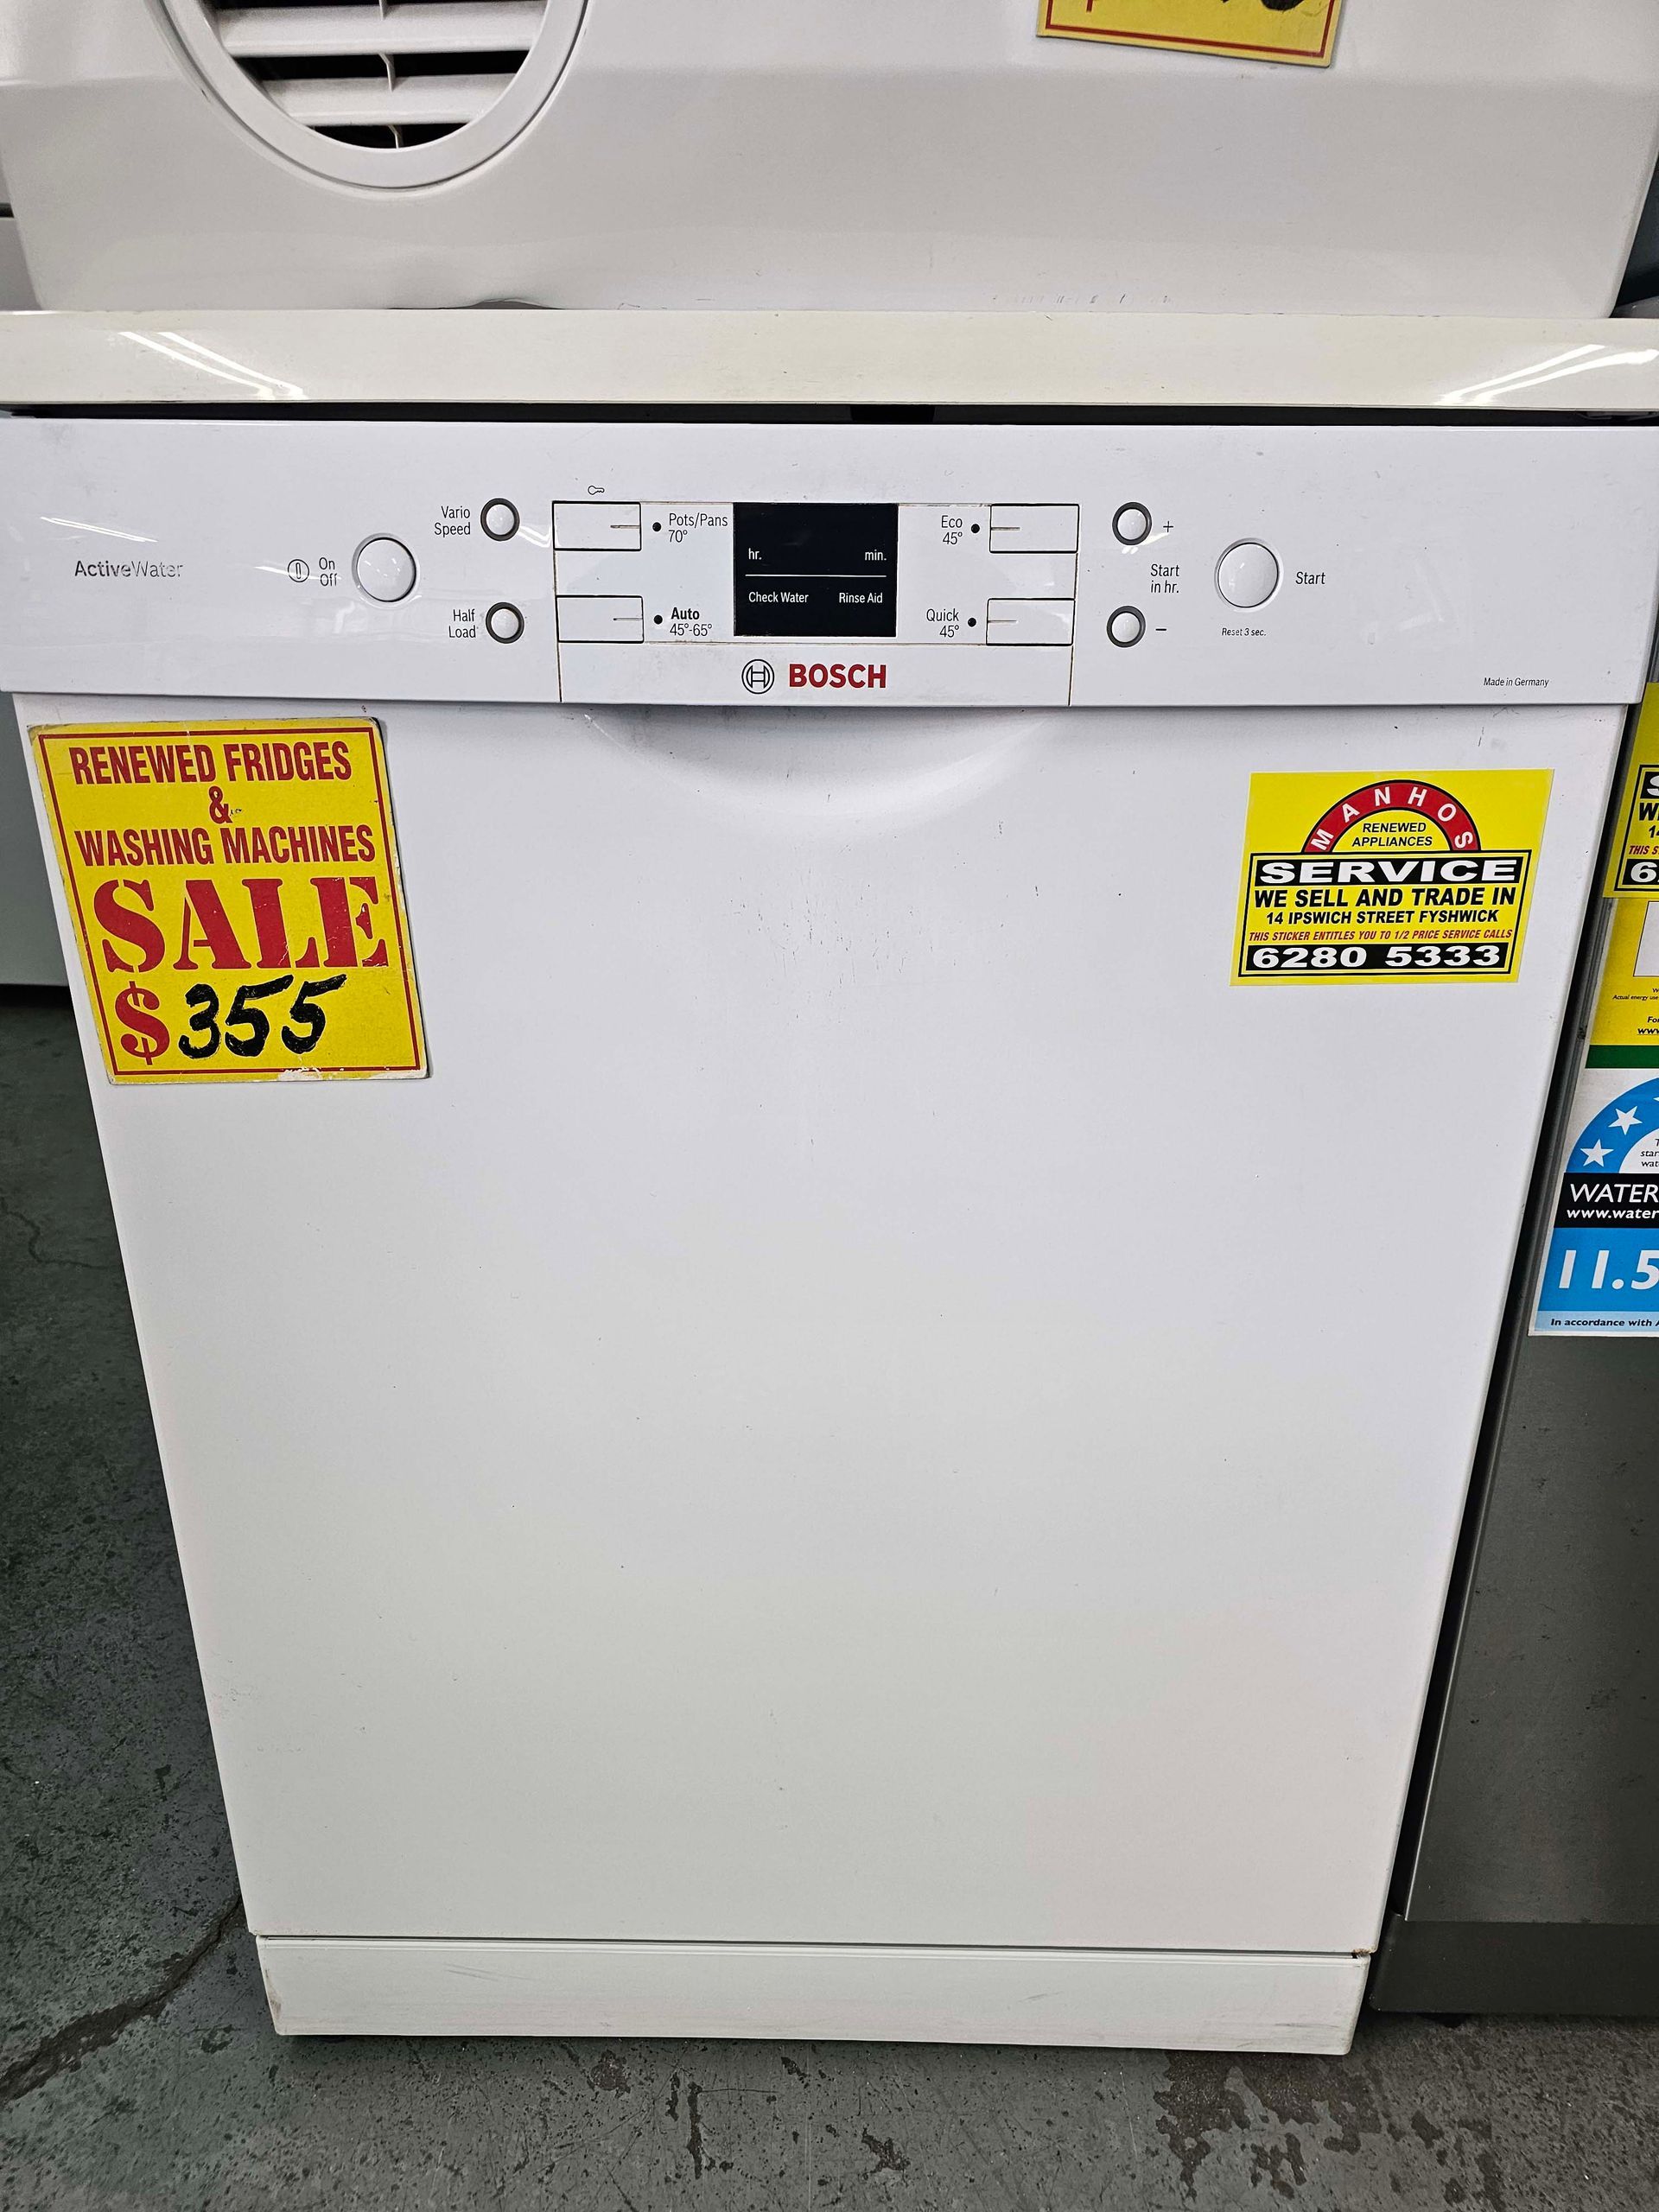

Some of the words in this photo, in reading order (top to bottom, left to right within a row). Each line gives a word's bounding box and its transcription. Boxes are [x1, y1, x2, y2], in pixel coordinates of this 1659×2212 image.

[442, 506, 471, 519] Vario
[669, 513, 728, 528] Pots/Pans
[941, 517, 963, 528] Eco
[435, 522, 471, 538] Speed
[748, 548, 762, 560] hr.
[865, 550, 887, 562] min.
[74, 560, 183, 577] ActiveWater
[319, 558, 335, 570] On
[1150, 564, 1179, 577] Start
[320, 573, 338, 586] Off
[1295, 571, 1325, 585] Start
[1151, 581, 1161, 594] in
[1164, 581, 1179, 594] hr.
[748, 591, 778, 603] Check
[780, 593, 809, 603] Water
[839, 593, 865, 603] Rinse
[867, 593, 883, 603] Aid
[453, 610, 475, 622] Half
[671, 607, 700, 620] Auto
[926, 608, 959, 624] Quick
[448, 626, 476, 639] Load
[1221, 627, 1242, 636] Reset
[1244, 627, 1249, 636] 3
[789, 664, 887, 689] BOSCH
[1484, 677, 1504, 686] Made
[1506, 677, 1513, 686] in
[1515, 677, 1549, 688] Germany
[69, 743, 215, 785] RENEWED
[223, 741, 352, 782] FRIDGES
[208, 786, 233, 823] &
[1312, 787, 1473, 851] MANHOS
[1363, 822, 1427, 834] RENEWED
[75, 828, 214, 867] WASHING
[221, 824, 376, 864] MACHINES
[1352, 836, 1433, 847] APPLIANCES
[1629, 846, 1649, 855] THIS
[1260, 860, 1517, 884] SERVICE
[1255, 889, 1288, 908] WE
[1295, 889, 1350, 907] SELL
[1356, 888, 1403, 906] AND
[1411, 887, 1484, 906] TRADE
[1491, 887, 1516, 905] IN
[1267, 912, 1283, 925] 14
[1288, 912, 1351, 925] IPSWICH
[1357, 911, 1415, 924] STREET
[1420, 910, 1498, 923] FYSHWICK
[93, 876, 390, 973] SALE
[1249, 932, 1269, 942] THIS
[1272, 931, 1310, 941] STICKER
[1313, 931, 1355, 941] ENTITLES
[1358, 931, 1377, 940] YOU
[1380, 931, 1390, 939] TO
[1395, 931, 1409, 939] 1/2
[1412, 930, 1440, 939] PRICE
[1442, 930, 1481, 939] SERVICE
[1484, 929, 1512, 938] CALLS
[1253, 946, 1367, 968] 6280
[1384, 945, 1500, 967] 5333
[1570, 1183, 1659, 1203] WATER
[1559, 1249, 1659, 1290] 11.5
